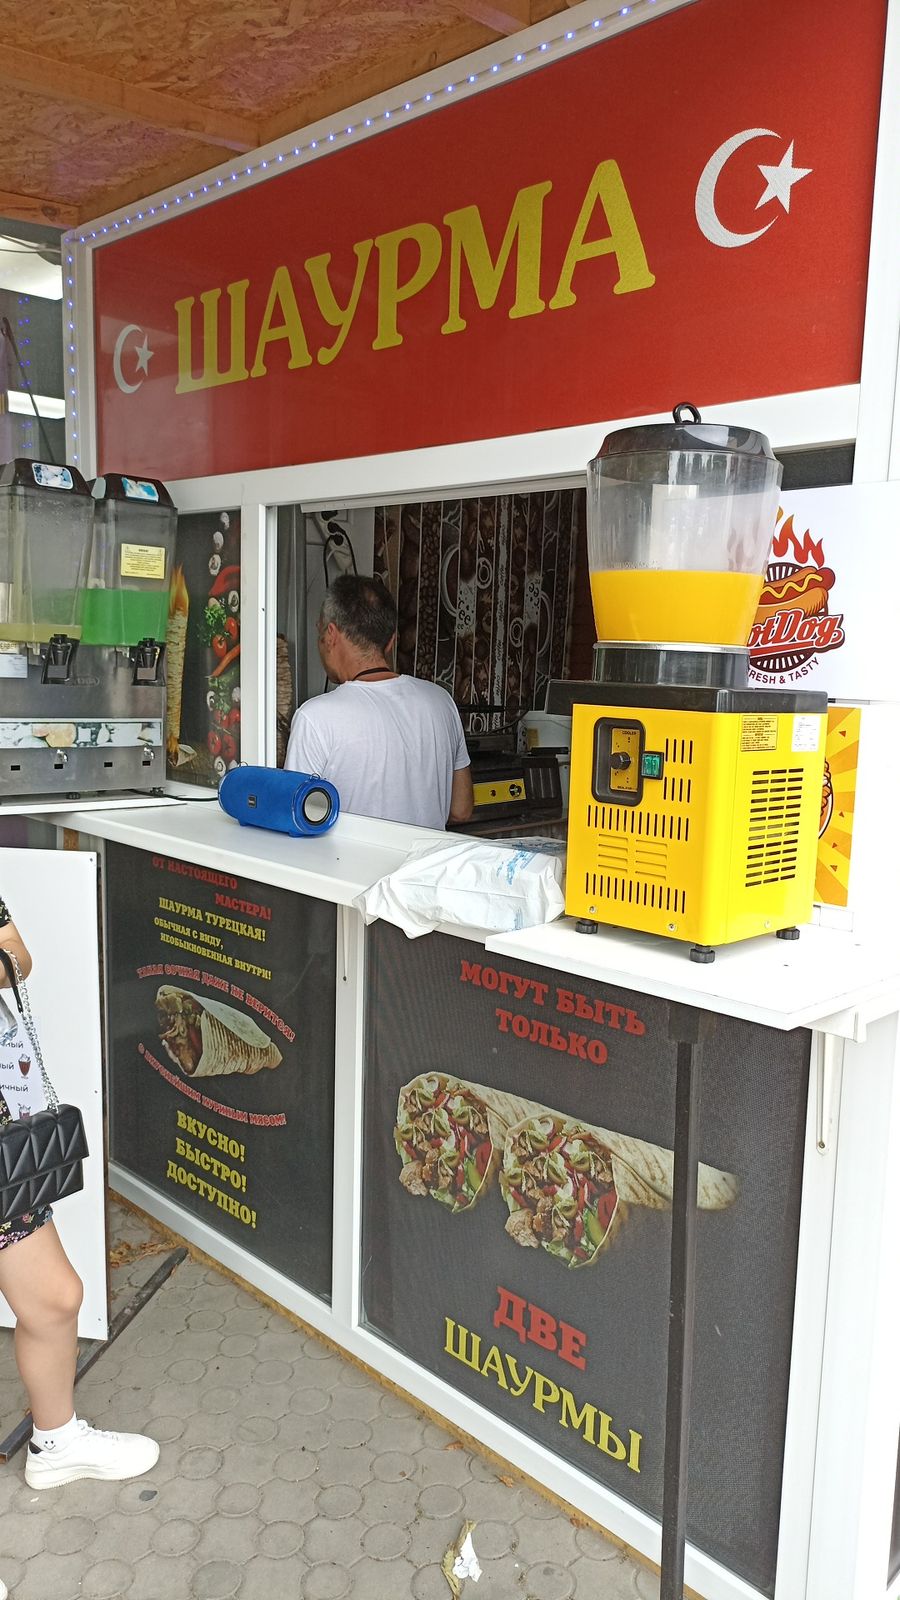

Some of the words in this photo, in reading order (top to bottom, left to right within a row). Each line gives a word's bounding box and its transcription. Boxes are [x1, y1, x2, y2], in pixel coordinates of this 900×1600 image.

[174, 158, 657, 394] ШАУРМА
[747, 608, 845, 654] otDog
[748, 669, 776, 684] RESH
[779, 675, 786, 684] &
[788, 656, 819, 682] TASTY
[152, 856, 165, 869] ОТ
[168, 860, 238, 890] НАСТОЯЩЕГО
[159, 897, 203, 921] ШАУРМА
[205, 912, 266, 942] ТУРЕЦКАЯ!
[215, 893, 273, 920] МАСТЕРА!
[154, 917, 191, 937] ОБЫЧНАЯ
[192, 930, 198, 939] С
[200, 933, 224, 950] ВИДУ,
[160, 932, 233, 966] НЕОБЫКНОВЕННАЯ
[235, 958, 272, 980] ВНУТРИ!
[165, 964, 200, 981] СОЧНАЯ
[202, 971, 229, 993] ДАЖЕ
[230, 983, 244, 1001] НЕ
[246, 993, 296, 1043] ВЕРИТСЯ!
[459, 959, 549, 1006] МОГУТ
[556, 987, 646, 1036] БЫТЬ
[495, 1008, 608, 1065] ТОЛЬКО
[177, 1110, 245, 1163] ВКУСНО!
[201, 1095, 249, 1123] КУРИНЫМ
[249, 1112, 288, 1127] МЯСОМ!
[175, 1137, 247, 1193] БЫСТРО!
[166, 1160, 257, 1229] ДОСТУПНО!
[493, 1286, 588, 1371] ДВЕ
[444, 1317, 643, 1473] ШАУРМЫ
